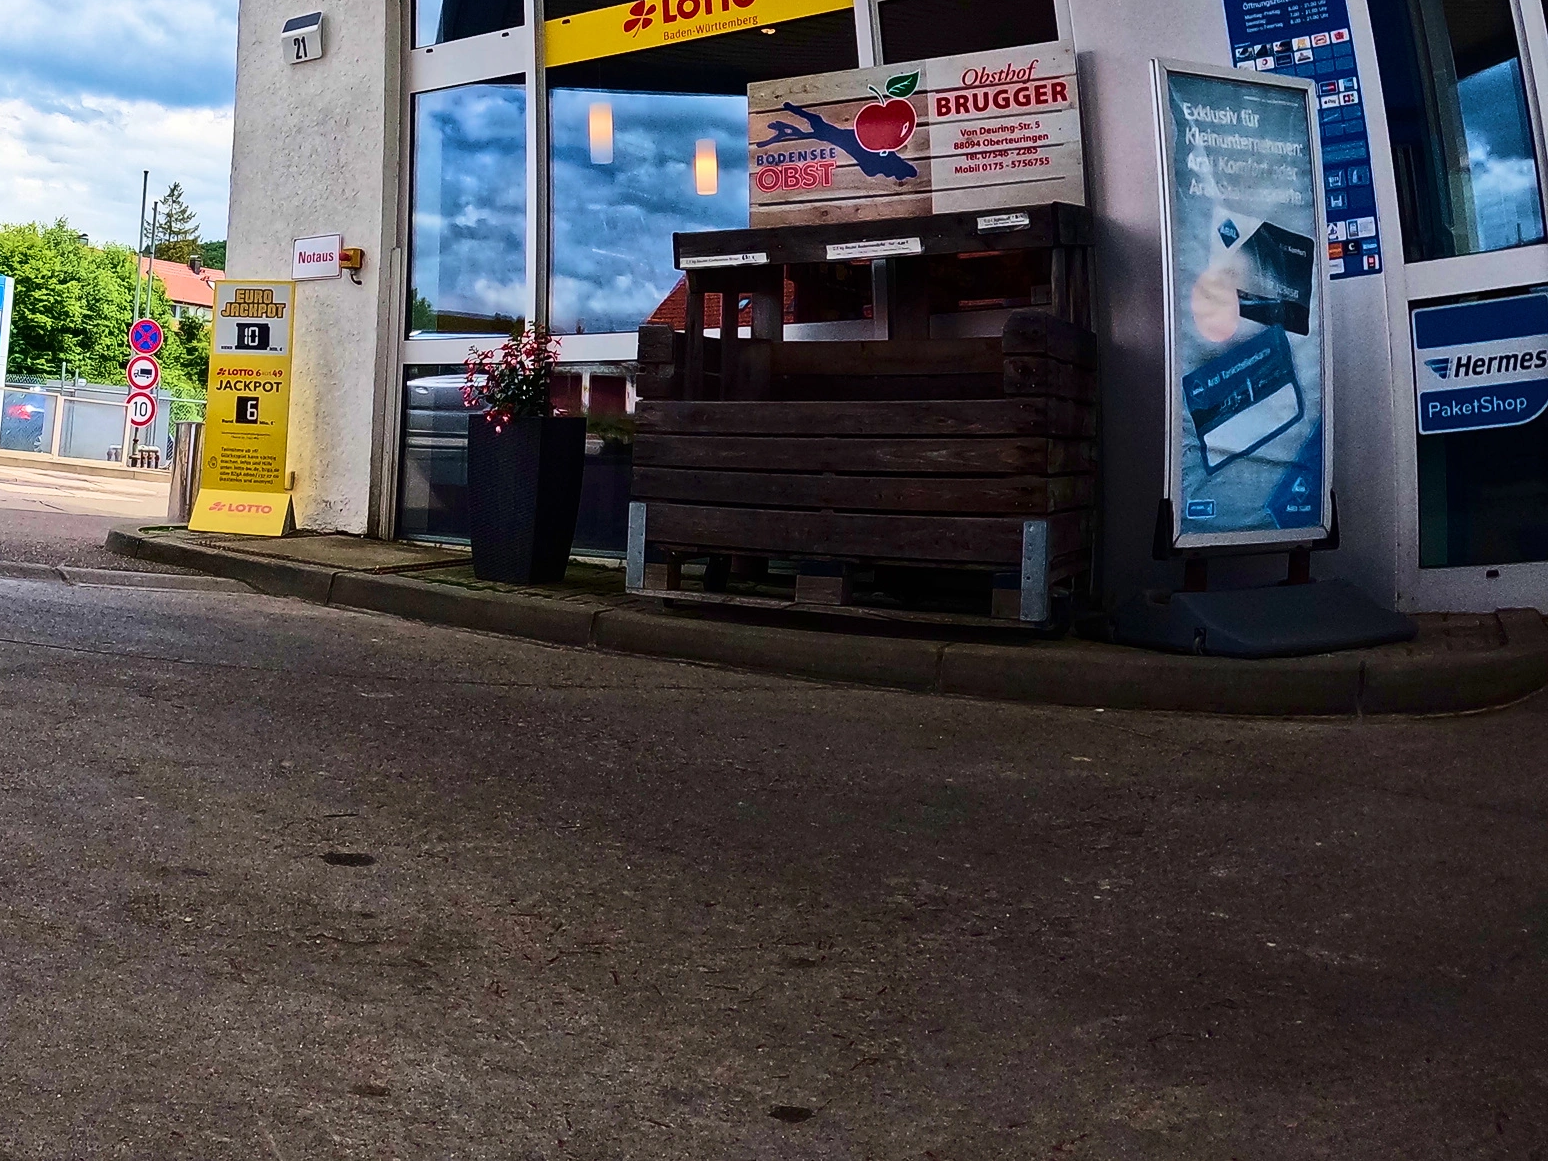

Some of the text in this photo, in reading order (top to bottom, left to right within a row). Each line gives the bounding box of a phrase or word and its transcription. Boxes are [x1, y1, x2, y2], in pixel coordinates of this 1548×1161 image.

[663, 14, 759, 41] Baden-Württemberg
[293, 36, 308, 60] 21
[961, 59, 1040, 87] Obsthof
[935, 81, 1069, 117] BRUGGER
[1182, 102, 1260, 128] Exklusiv für
[960, 120, 1041, 137] Von Deuring-Str. 5
[954, 134, 1049, 150] 88094 Oberteuringen
[756, 147, 837, 167] BODENSEE
[981, 149, 1009, 160] 07546
[954, 163, 980, 174] Mobil
[982, 161, 1004, 172] 0175
[1011, 157, 1050, 169] 5756755
[756, 161, 836, 193] OBST
[298, 250, 334, 264] Notaus
[235, 289, 273, 303] EURO
[221, 302, 286, 318] JACKPOT
[244, 327, 259, 346] 10
[1454, 349, 1548, 378] Hermes
[227, 368, 254, 377] LOTTO
[255, 369, 262, 377] 6
[272, 369, 283, 378] 49
[216, 379, 283, 393] JACKPOT
[133, 401, 148, 417] 10
[246, 400, 257, 420] 6
[1428, 395, 1527, 418] PaketShop
[227, 503, 272, 514] LOTTO
